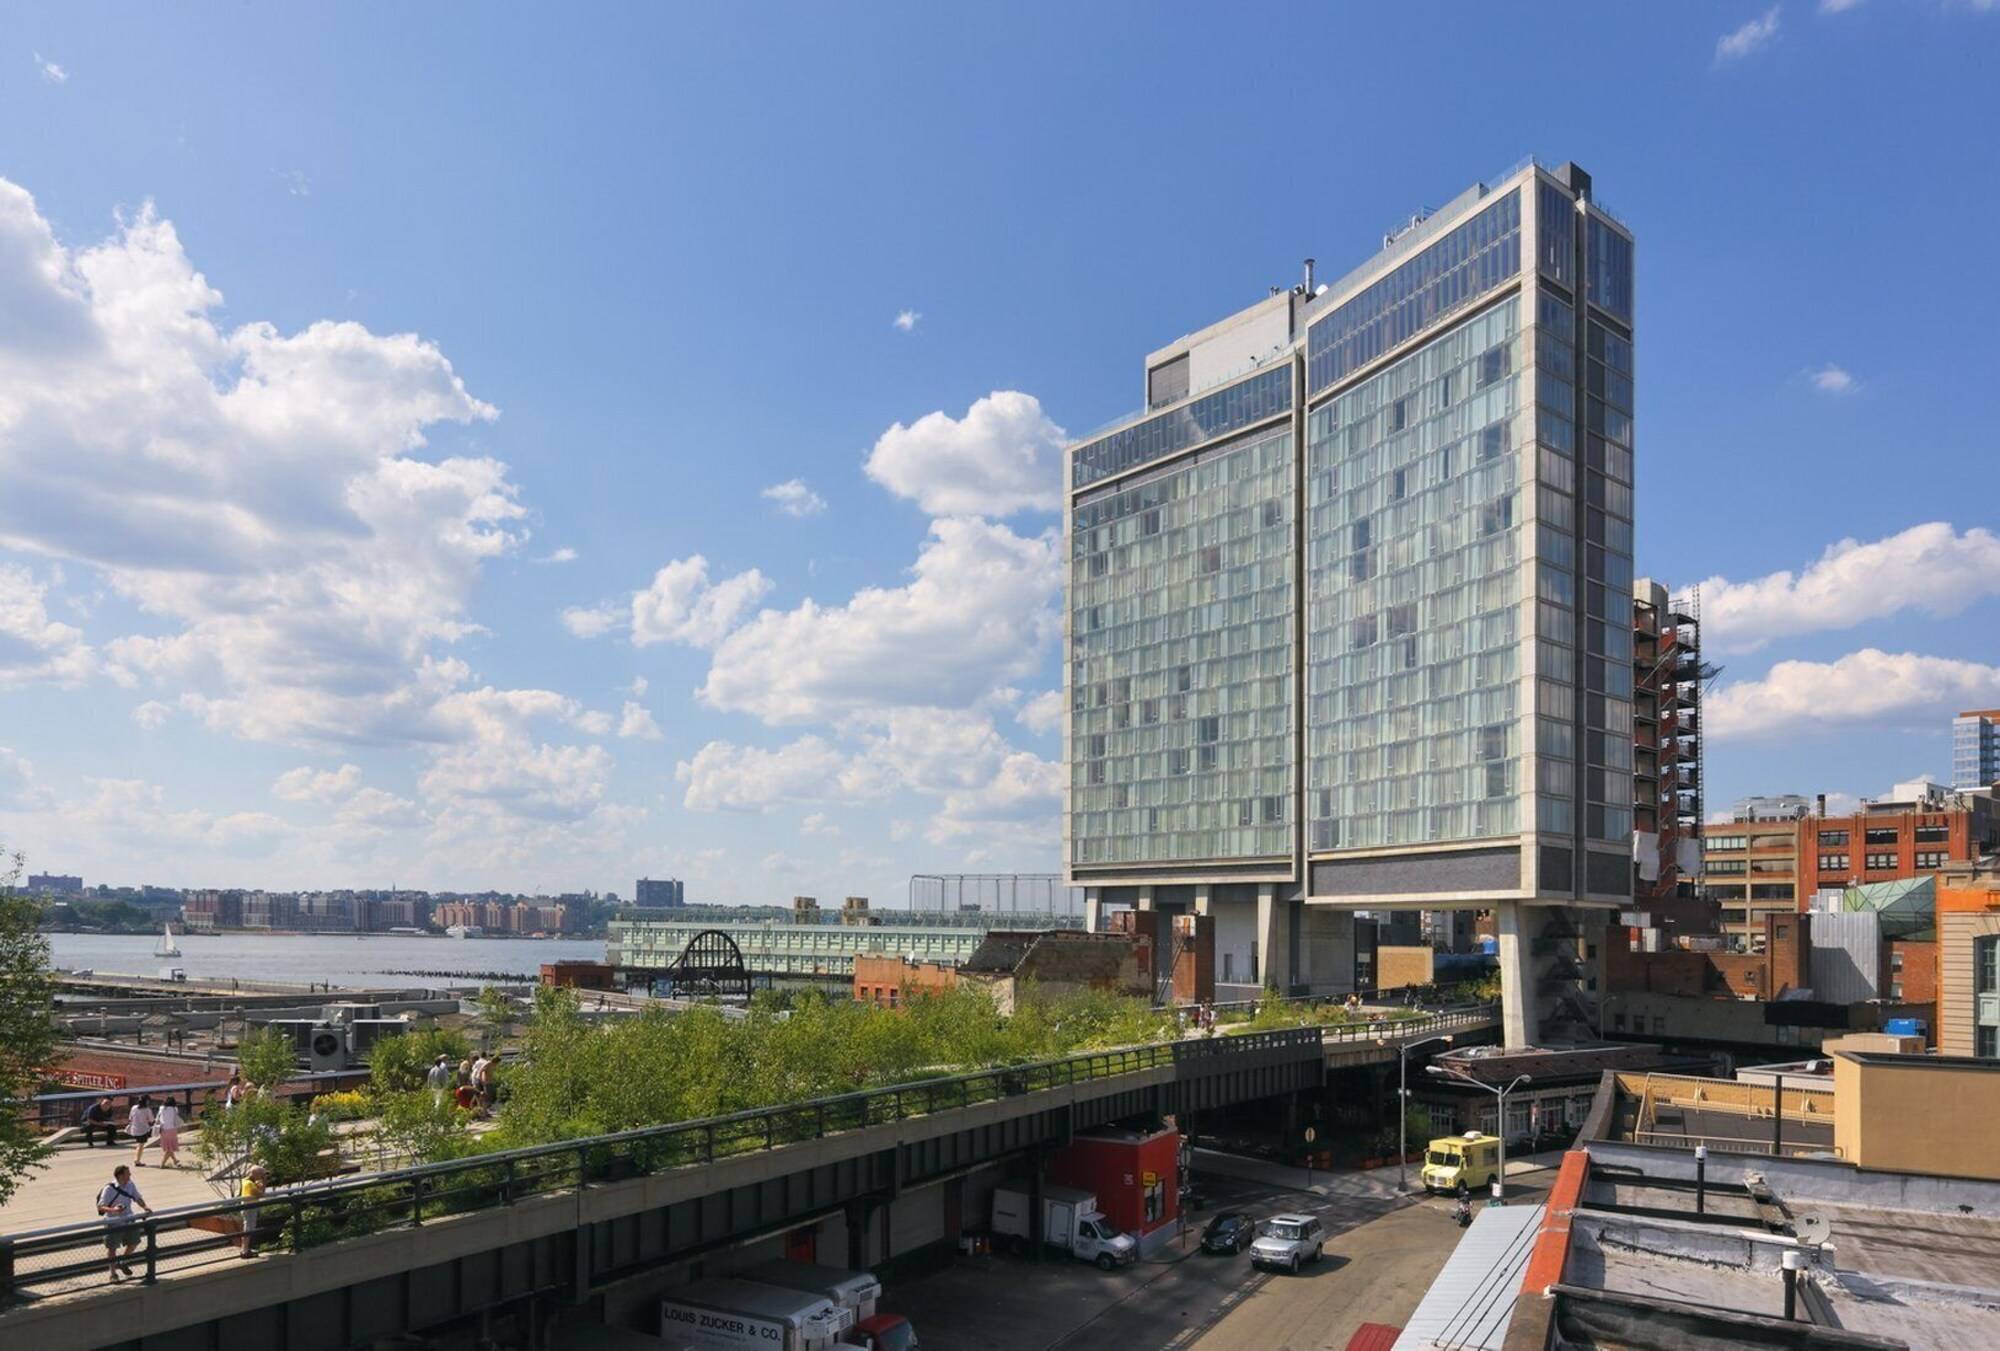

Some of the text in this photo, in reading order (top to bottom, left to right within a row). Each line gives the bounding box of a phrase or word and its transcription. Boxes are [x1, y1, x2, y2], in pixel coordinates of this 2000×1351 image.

[664, 1306, 696, 1324] LOUIS
[700, 1314, 745, 1334] ZUCKER
[748, 1325, 757, 1336] &
[760, 1327, 781, 1341] CO.
